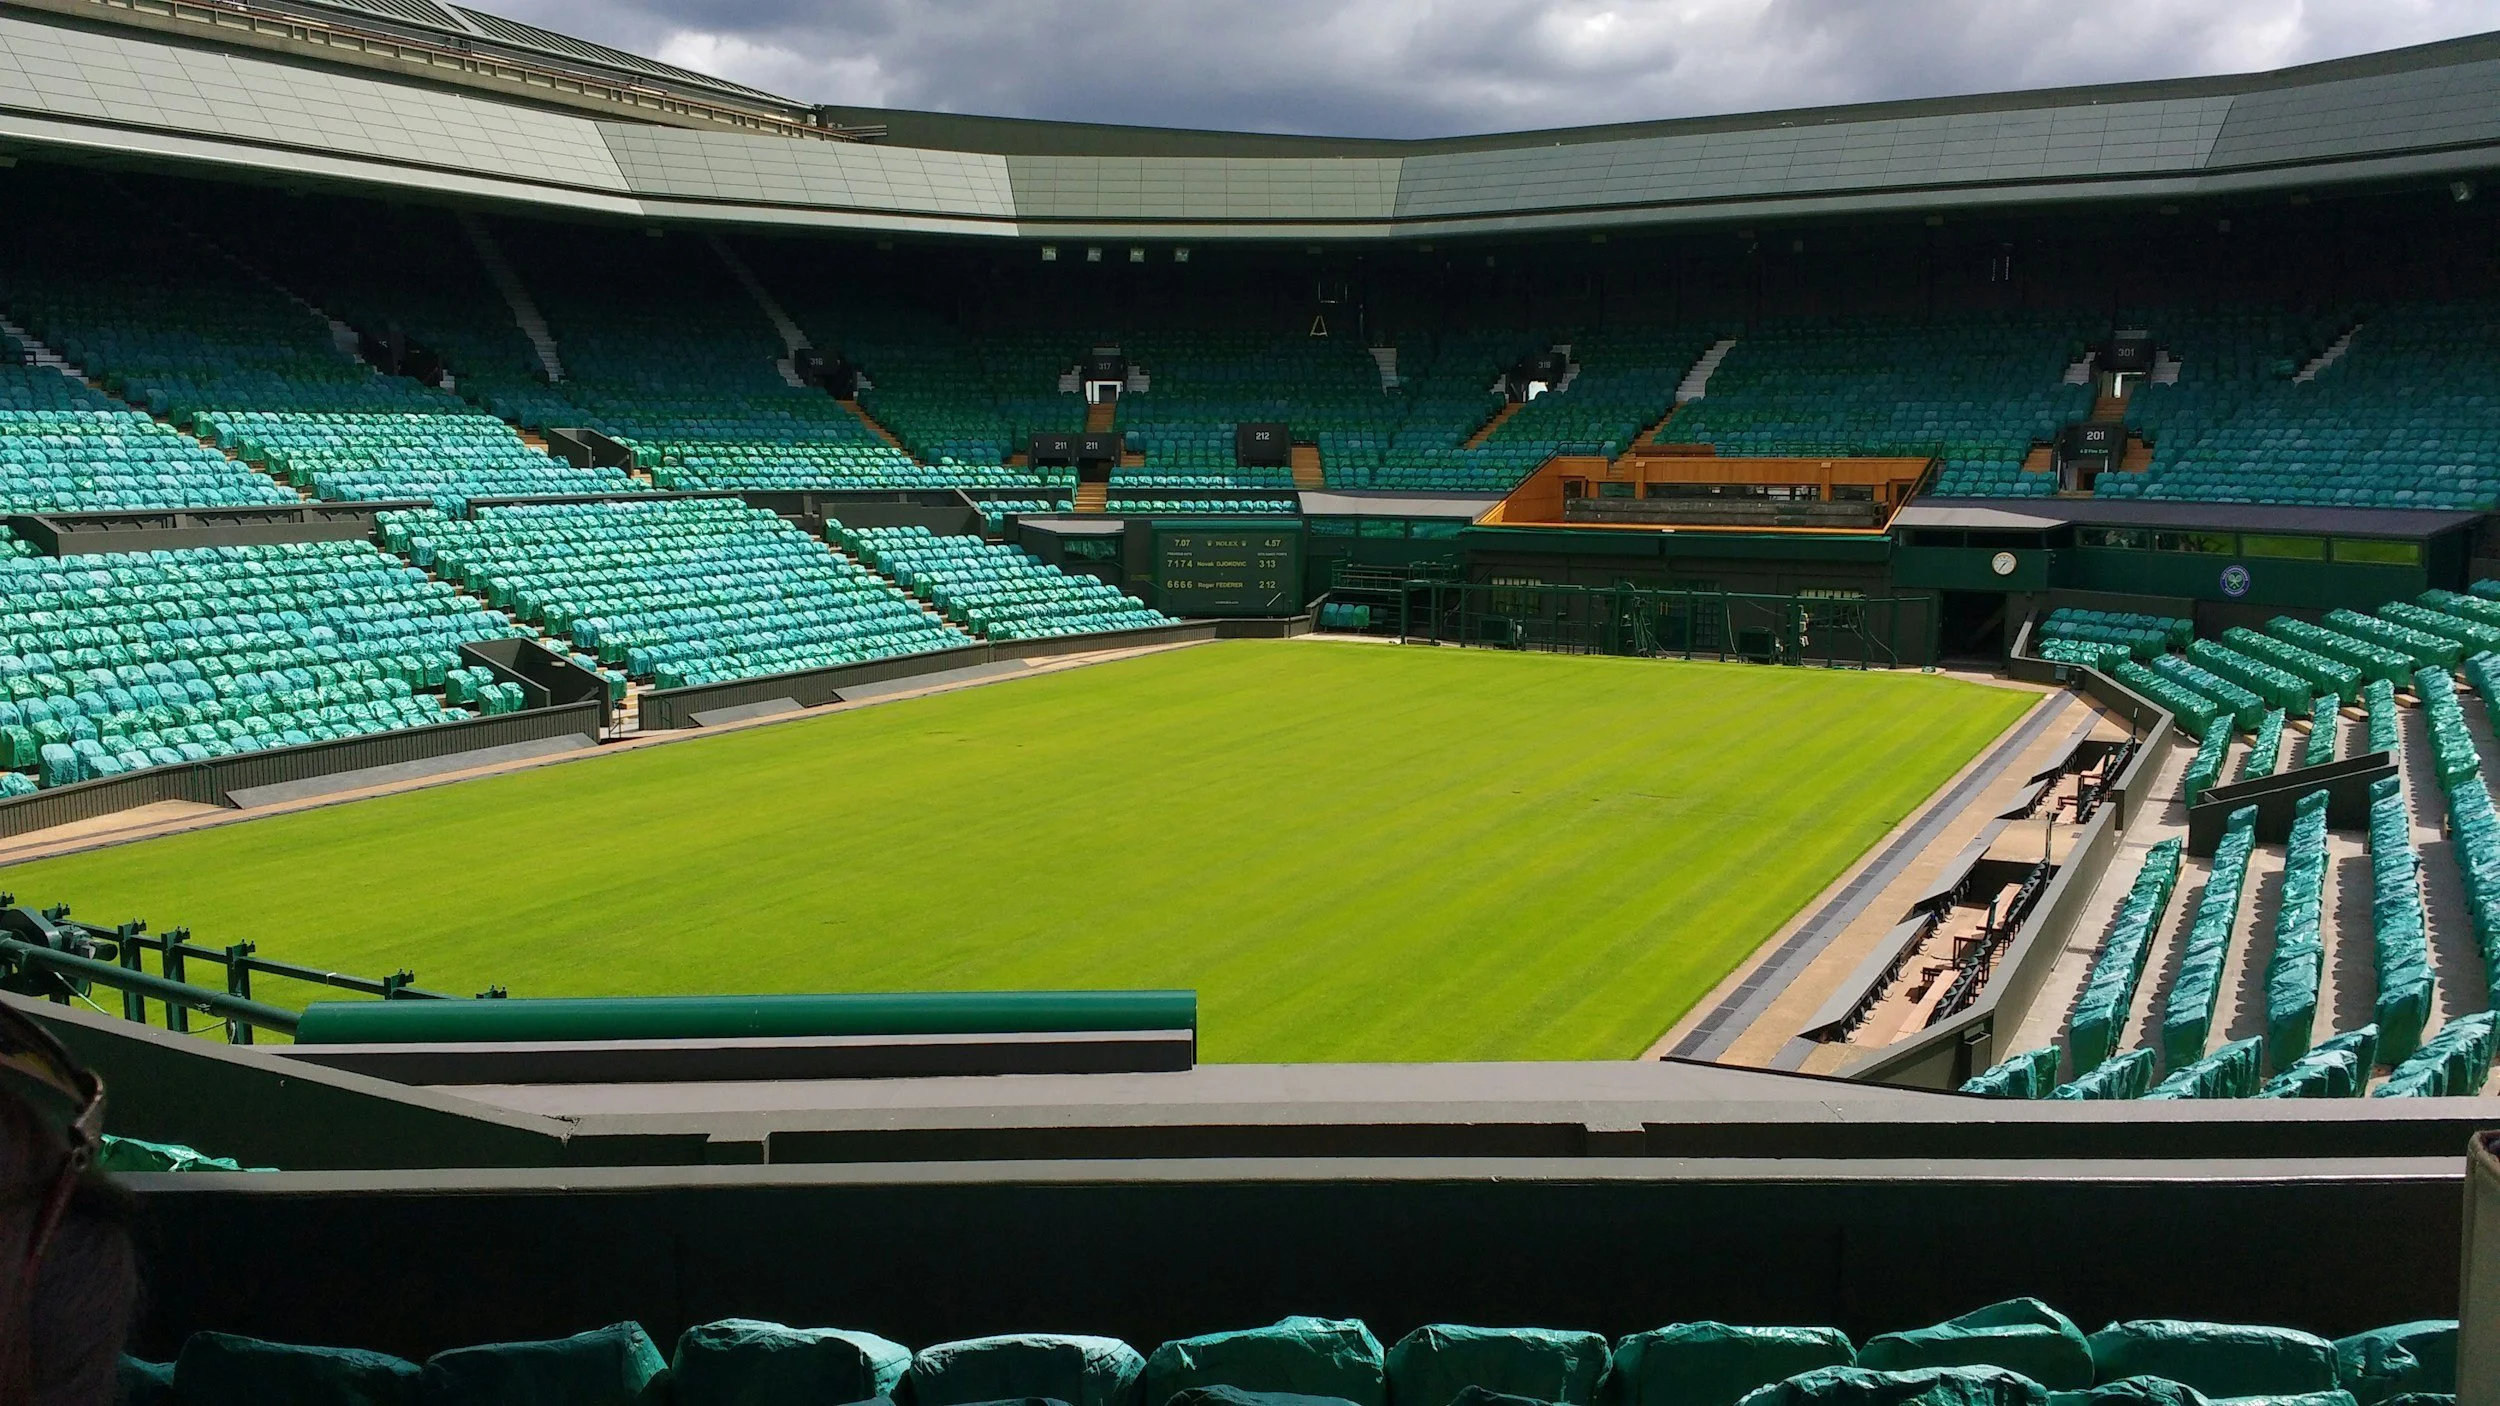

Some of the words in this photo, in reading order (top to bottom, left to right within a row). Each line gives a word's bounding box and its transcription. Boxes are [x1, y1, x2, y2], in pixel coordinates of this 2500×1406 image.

[2118, 348, 2135, 357] 301
[1255, 431, 1270, 441] 212
[2086, 430, 2105, 441] 201
[1054, 441, 1067, 450] 211
[1085, 441, 1099, 450] 211
[1174, 539, 1191, 547] 7.07
[1264, 539, 1281, 548] 4.57
